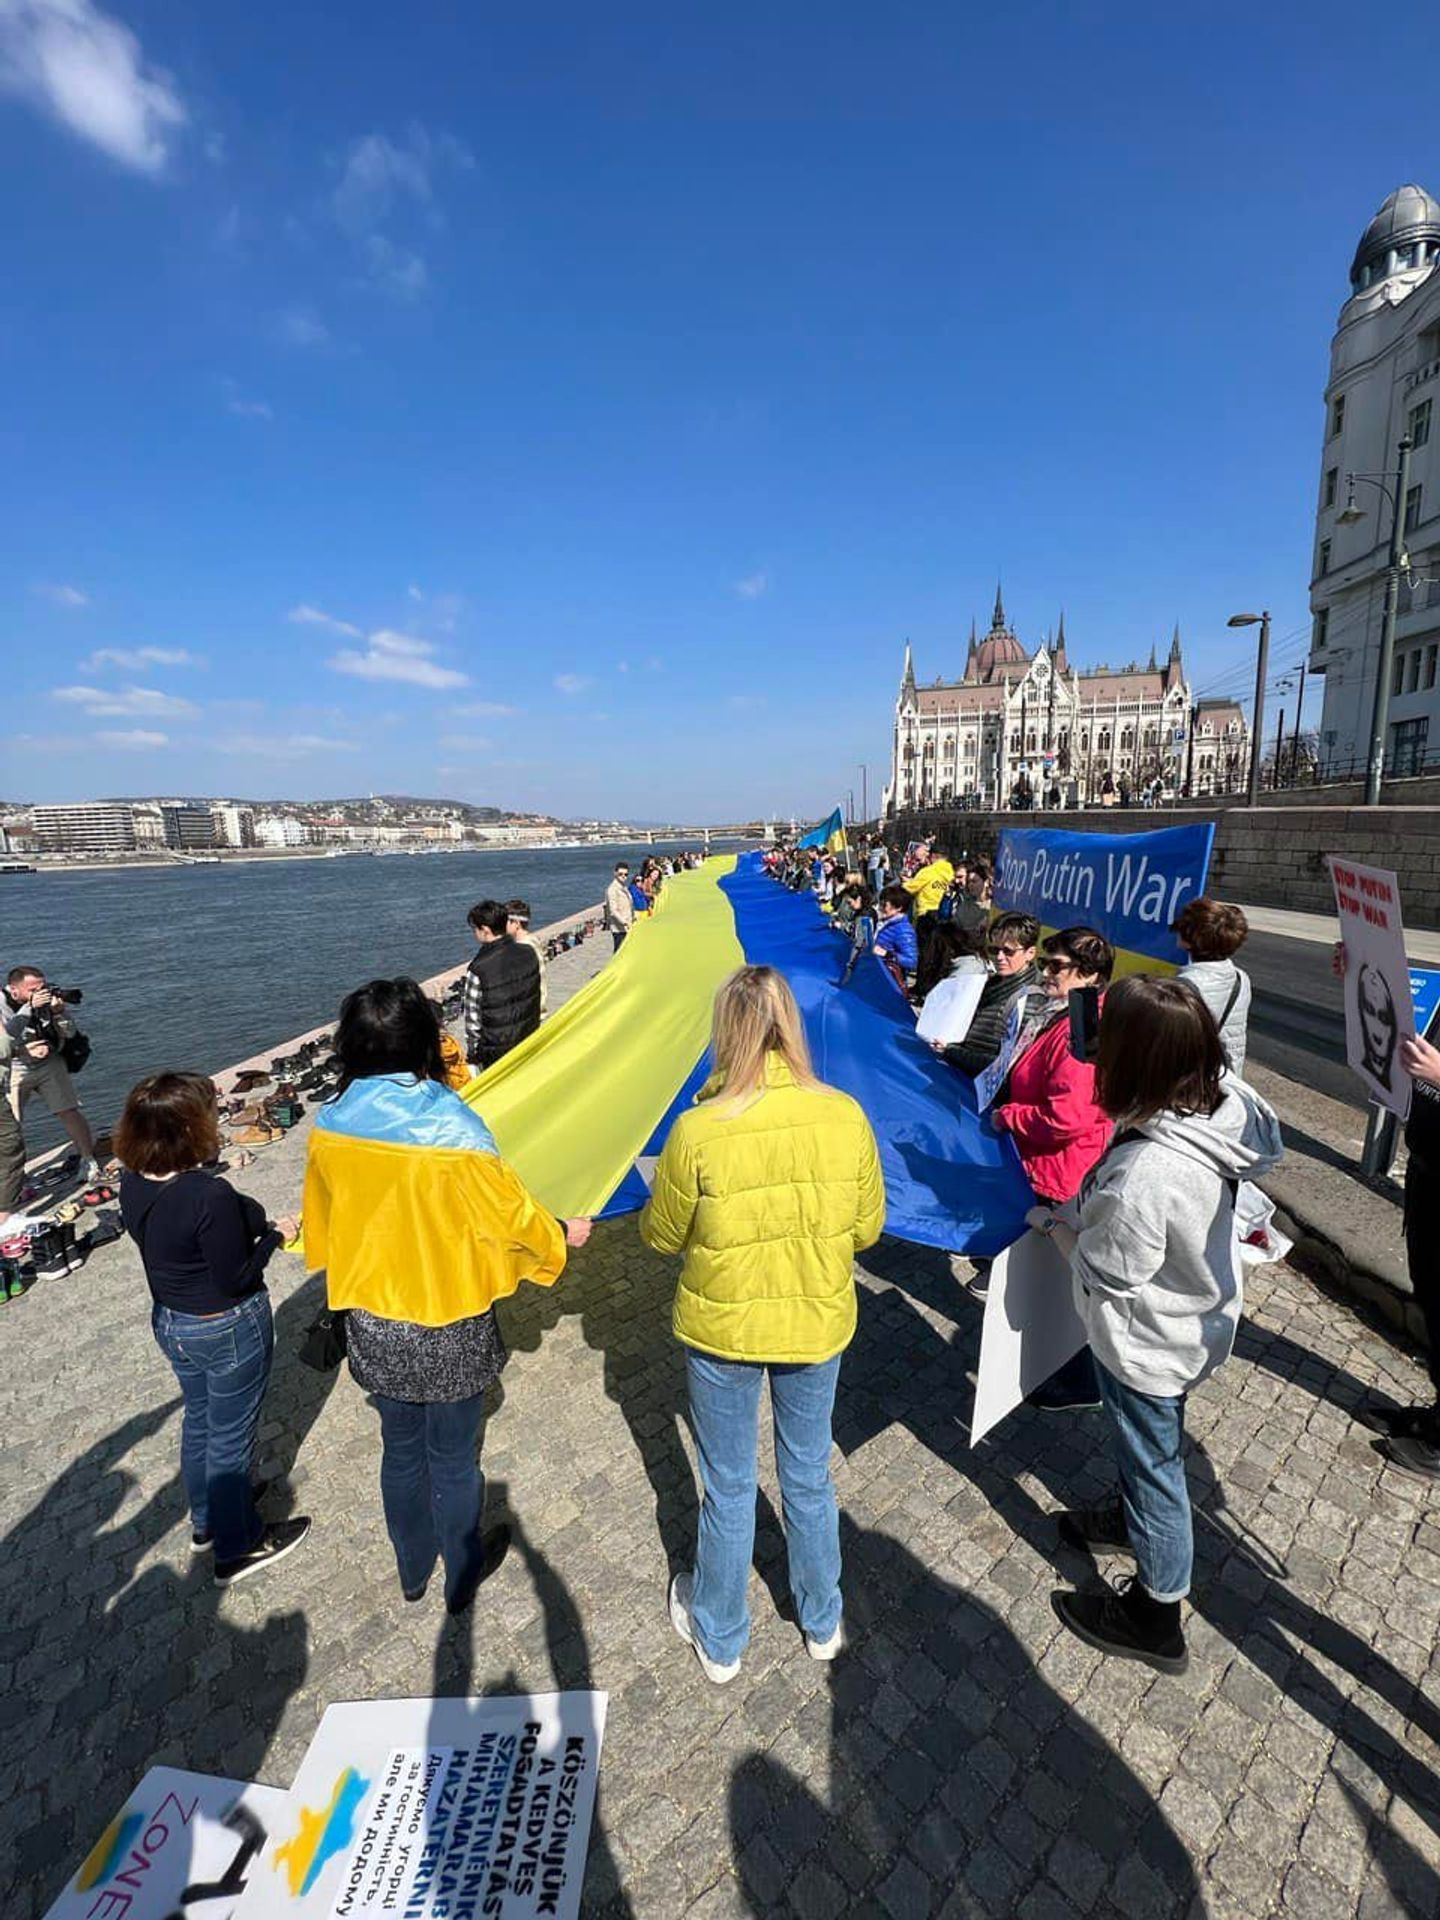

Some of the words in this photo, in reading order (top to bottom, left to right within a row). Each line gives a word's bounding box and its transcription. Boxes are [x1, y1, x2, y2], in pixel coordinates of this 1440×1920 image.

[996, 847, 1027, 903] Stop
[1029, 848, 1094, 909] Putin
[1105, 852, 1192, 926] War
[1338, 890, 1360, 916] STOP
[1362, 901, 1389, 929] WAR
[1359, 876, 1392, 903] PUTIN
[386, 1754, 405, 1788] але
[408, 1762, 421, 1780] за
[538, 1758, 556, 1776] A
[362, 1785, 413, 1906] гостинність,
[373, 1793, 391, 1821] ми
[404, 1750, 469, 1919] HAZATÉRNI
[482, 1722, 541, 1920] FOGADTATÁS
[514, 1784, 551, 1897] KEDVES
[537, 1736, 586, 1915] KÖSZÖNJÜK
[86, 1792, 199, 1920] ZONE
[336, 1827, 379, 1917] додому
[382, 1844, 413, 1910] угорці
